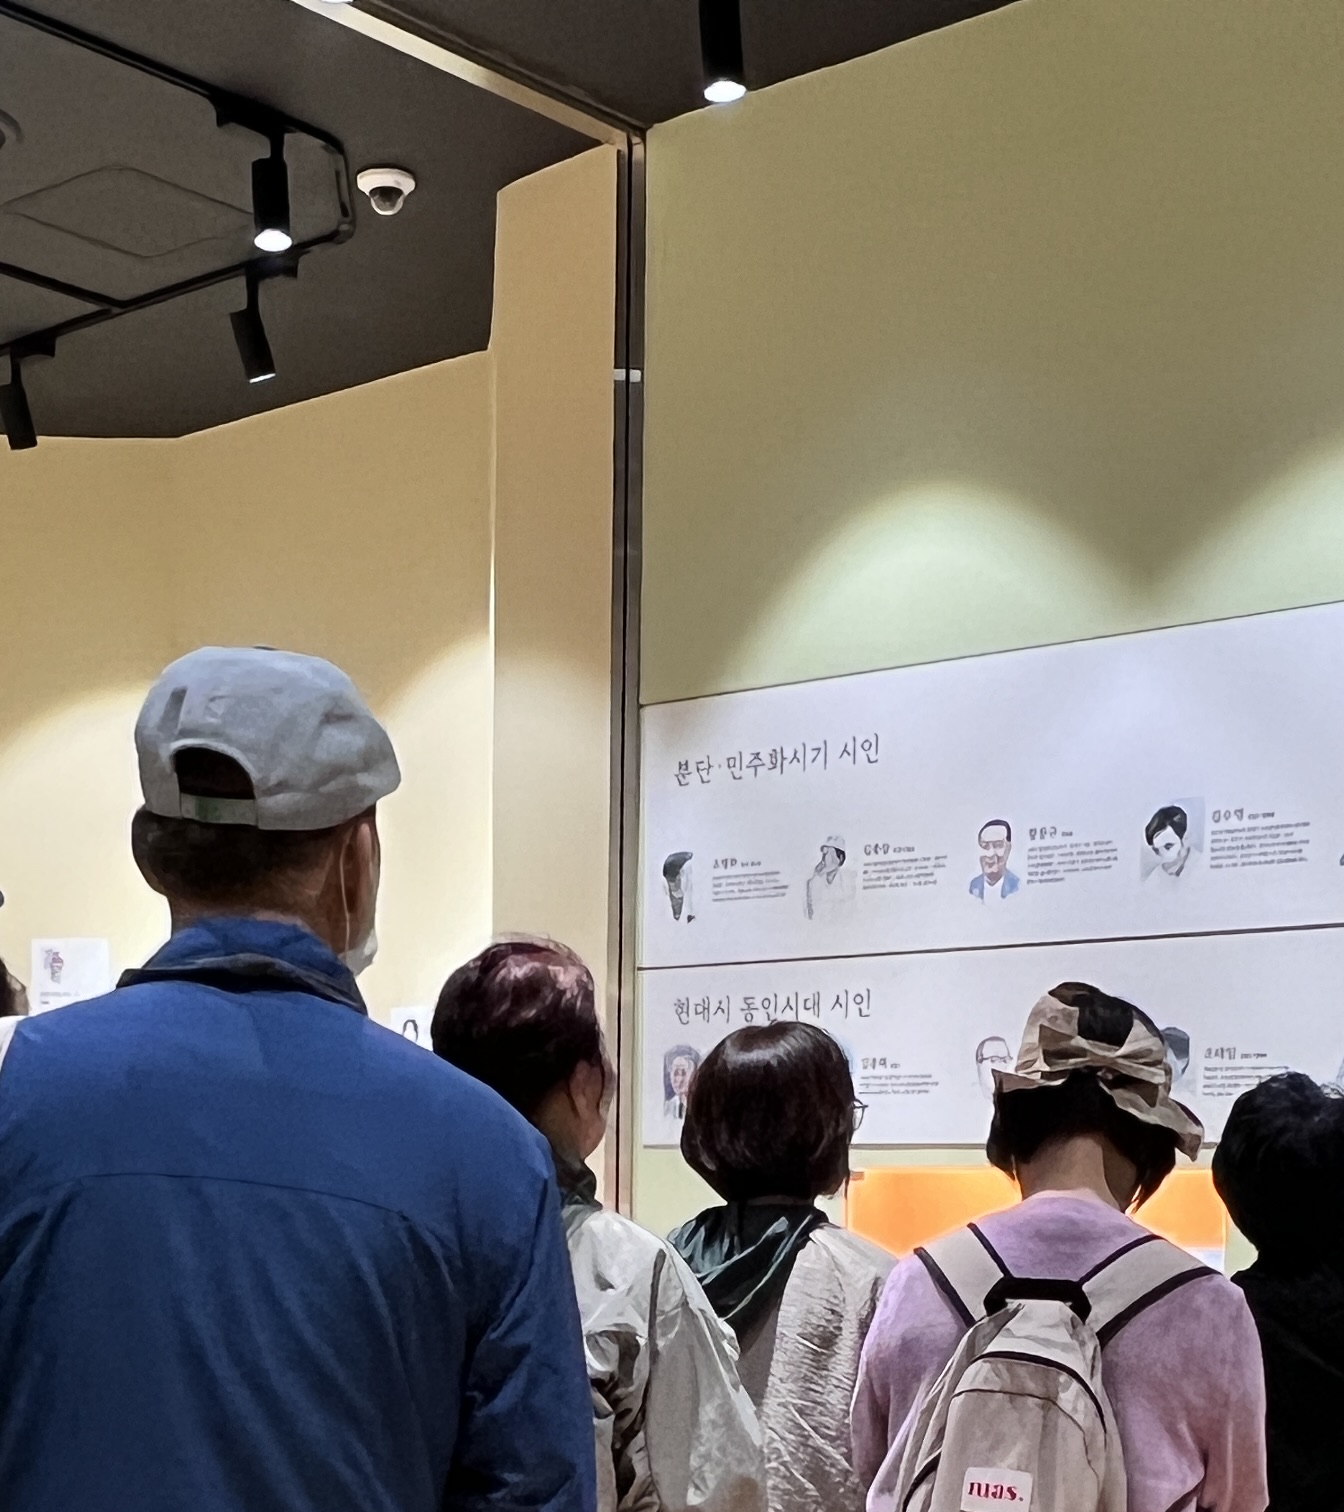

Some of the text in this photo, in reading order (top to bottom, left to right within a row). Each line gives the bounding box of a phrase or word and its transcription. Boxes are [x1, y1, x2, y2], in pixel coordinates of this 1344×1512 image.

[674, 733, 879, 787] 분단·민주화시기 시인
[674, 988, 871, 1026] 현대시 동인시대 시인
